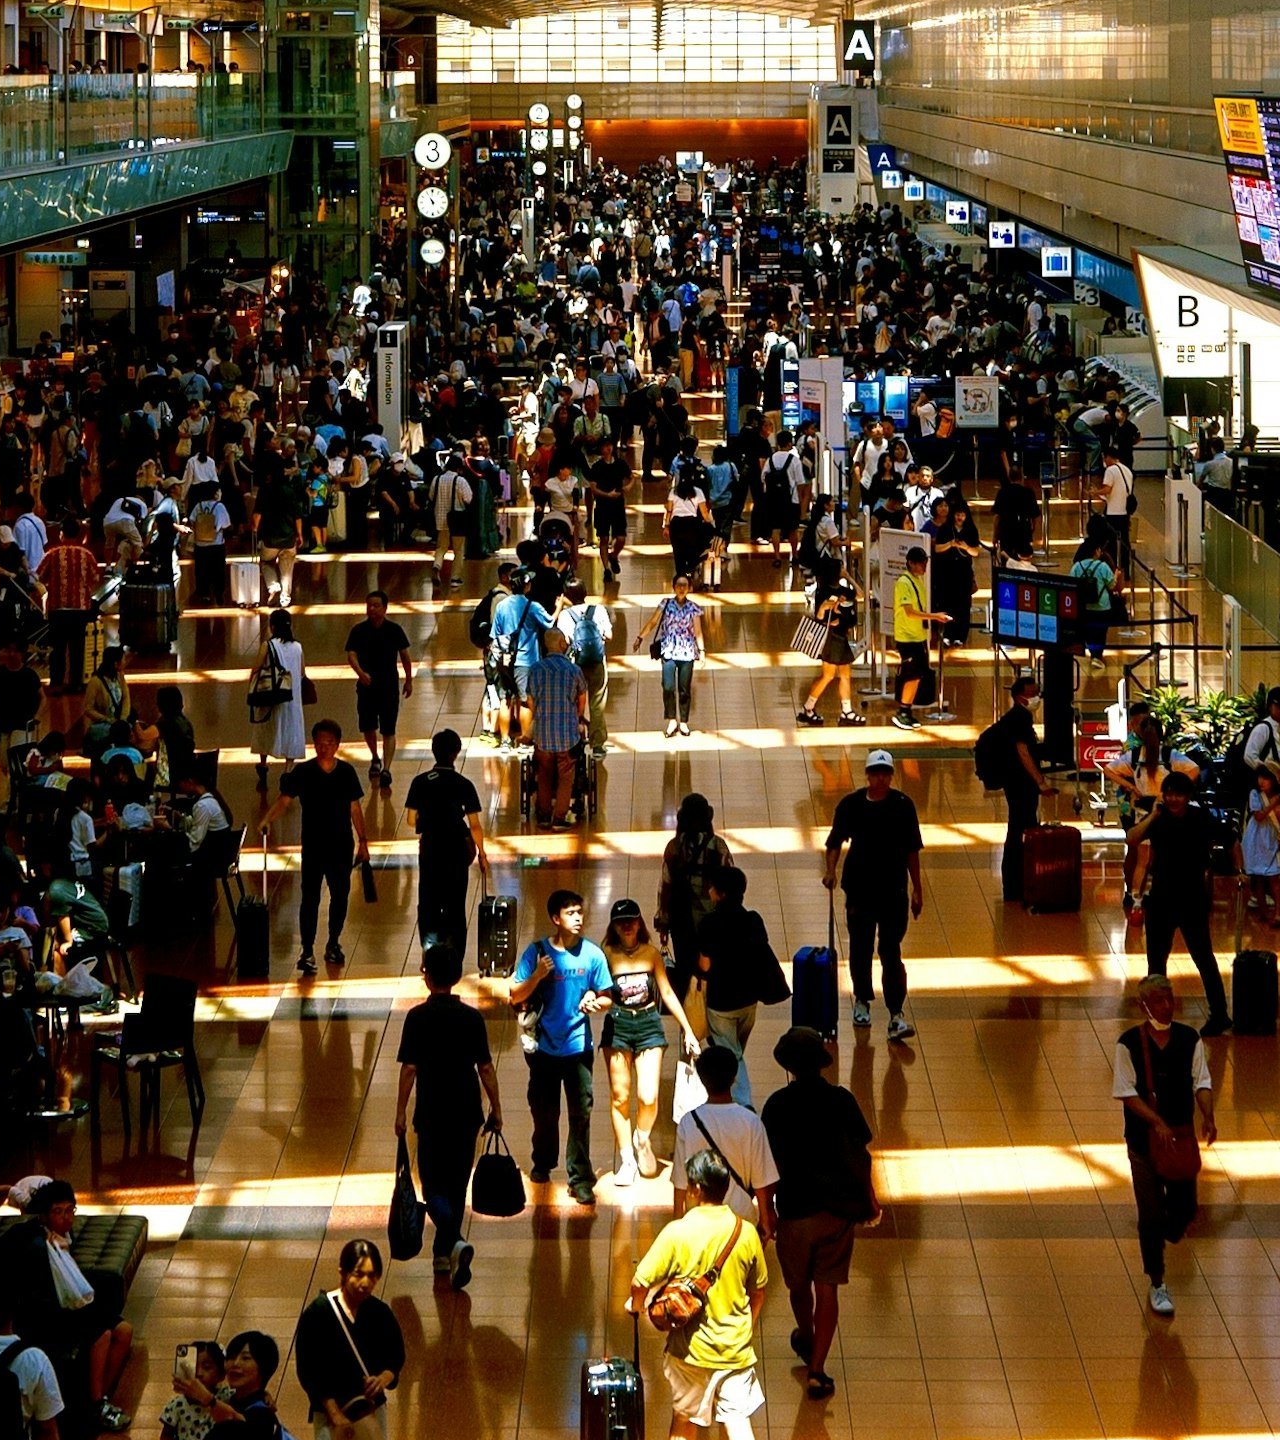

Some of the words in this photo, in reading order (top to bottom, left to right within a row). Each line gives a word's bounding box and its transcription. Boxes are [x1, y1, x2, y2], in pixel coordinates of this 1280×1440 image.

[844, 29, 874, 61] A
[535, 107, 543, 120] 2
[828, 113, 850, 137] A
[426, 140, 440, 163] 3
[876, 152, 892, 168] A
[1086, 288, 1099, 306] 3
[1177, 295, 1200, 328] B
[385, 353, 393, 405] Information
[1024, 589, 1031, 601] B
[1044, 592, 1051, 604] C
[1065, 596, 1072, 607] D
